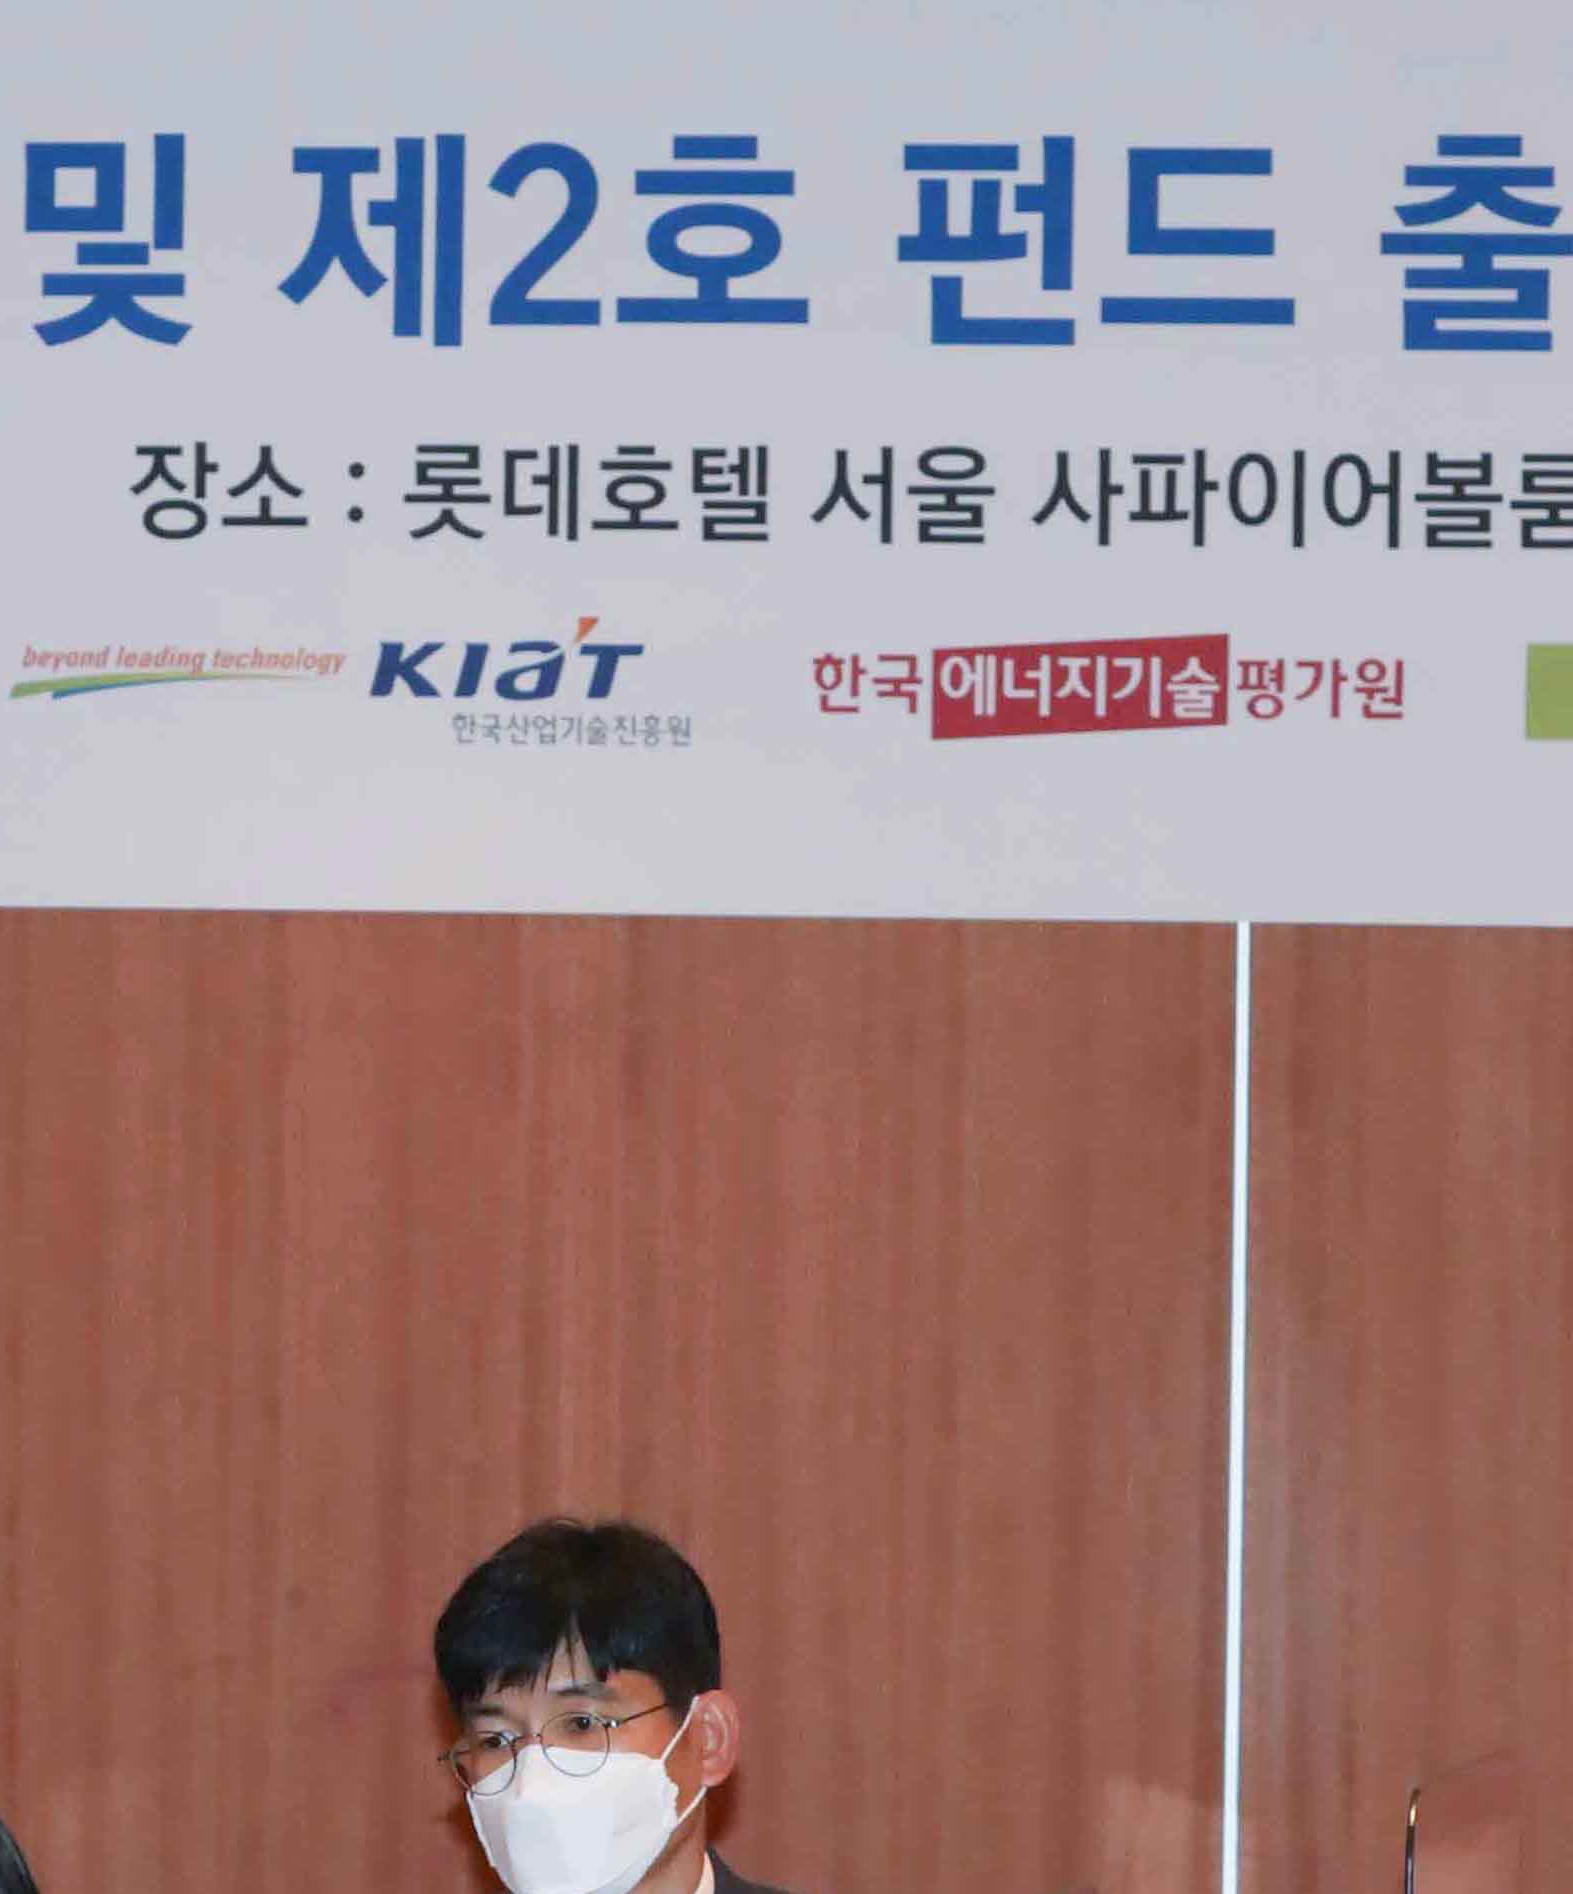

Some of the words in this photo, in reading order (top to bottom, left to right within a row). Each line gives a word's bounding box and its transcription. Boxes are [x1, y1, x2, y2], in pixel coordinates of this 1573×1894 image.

[25, 133, 191, 346] 및
[278, 134, 809, 346] 제2호
[898, 136, 1295, 346] 펀드
[131, 442, 308, 539] 장소
[404, 444, 768, 541] 롯데호텔
[812, 446, 995, 544] 서울
[21, 645, 110, 675] beyond
[115, 646, 207, 674] leading
[212, 645, 347, 676] technology
[452, 713, 691, 746] 한국산업기술진흥원
